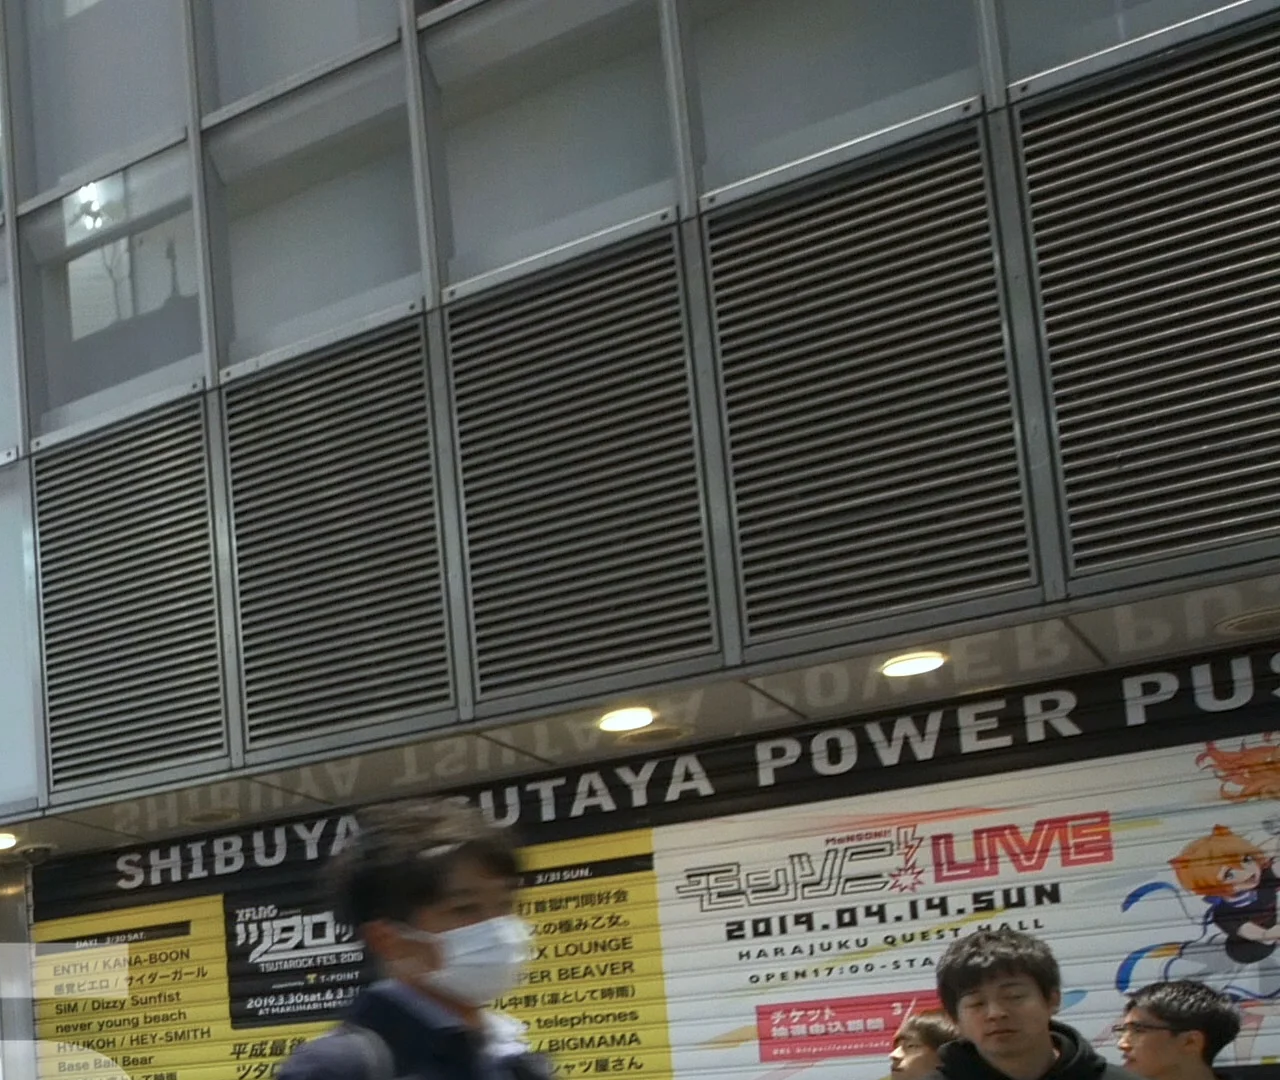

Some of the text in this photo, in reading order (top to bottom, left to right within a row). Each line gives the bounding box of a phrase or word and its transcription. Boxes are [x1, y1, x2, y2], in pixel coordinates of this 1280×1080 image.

[115, 812, 366, 890] SHIBUYA
[755, 688, 1085, 788] POWER
[929, 810, 1115, 885] LIVE
[725, 882, 1063, 942] 2019.04.14.SUN
[553, 936, 635, 958] LOUNGE
[738, 936, 870, 962] HARAJUKU
[883, 925, 962, 949] QUEST
[53, 962, 90, 977] ENTH
[102, 948, 191, 971] KANA-BOON
[558, 960, 635, 981] BEAVER
[125, 965, 208, 987] サイダーガール
[91, 996, 127, 1013] Dizzy
[130, 990, 182, 1007] Sunfist
[55, 1009, 187, 1034] never young beach
[535, 1008, 639, 1031] telephones
[770, 1006, 836, 1025] チケット
[57, 1036, 117, 1053] HYUKOH
[129, 1026, 212, 1046] HEY-SMITH
[547, 1031, 642, 1053] BIGMAMA
[58, 1054, 155, 1073] Base Ball Bear
